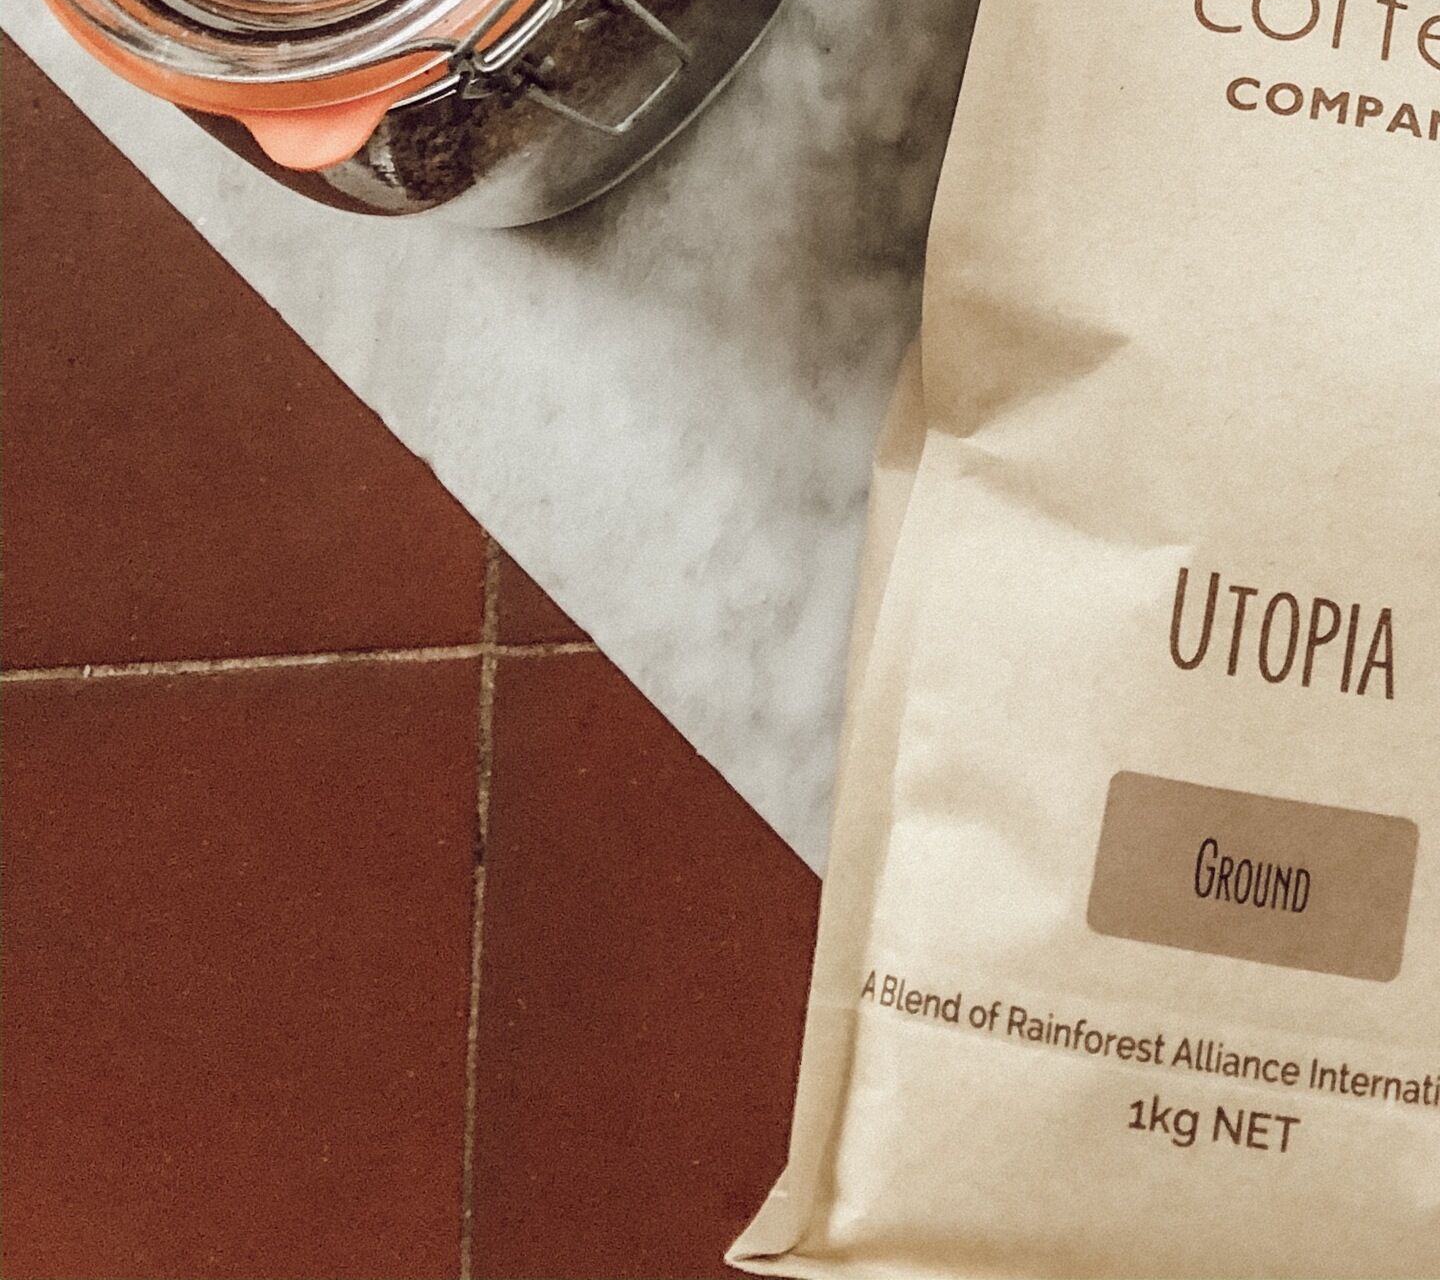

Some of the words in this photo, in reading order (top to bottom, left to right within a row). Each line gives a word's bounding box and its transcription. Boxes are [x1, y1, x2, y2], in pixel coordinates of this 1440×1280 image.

[1167, 567, 1397, 701] UTOPIA
[861, 970, 876, 1002] A
[879, 975, 961, 1026] Blend
[968, 1001, 1001, 1033] of
[1007, 1005, 1167, 1066] Rainforest
[1171, 1037, 1301, 1088] Alliance
[1127, 1097, 1201, 1148] 1kg
[1211, 1104, 1301, 1156] NET
